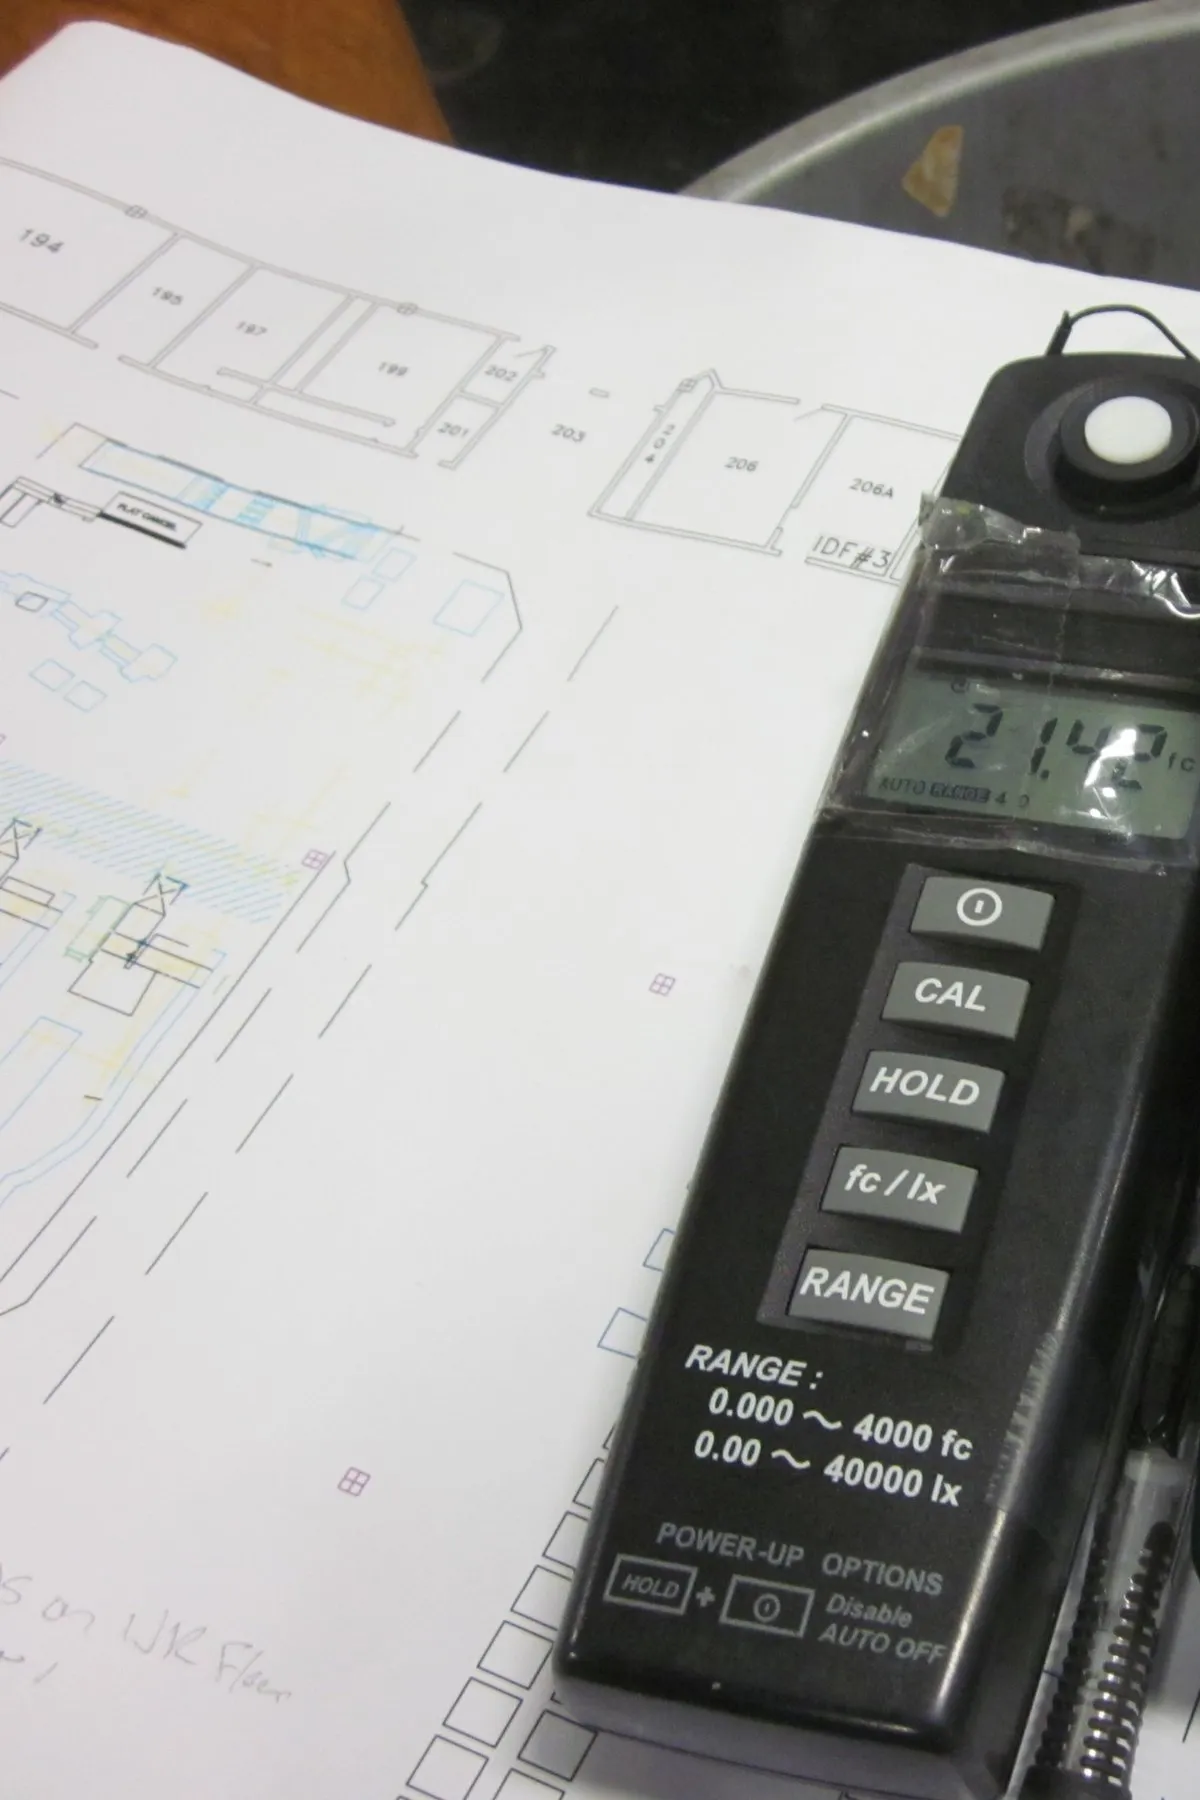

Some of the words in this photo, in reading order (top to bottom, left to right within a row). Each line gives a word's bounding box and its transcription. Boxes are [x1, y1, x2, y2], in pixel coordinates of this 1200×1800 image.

[19, 228, 64, 253] 194
[236, 321, 267, 336] 197
[485, 364, 517, 381] 202
[437, 422, 469, 437] 201
[551, 423, 586, 443] 203
[725, 456, 759, 473] 206
[850, 478, 894, 499] 206A
[813, 535, 892, 571] IDF#3
[878, 778, 926, 795] AUTO
[914, 977, 987, 1012] CAL
[869, 1066, 980, 1107] HOLD
[800, 1266, 935, 1314] RANGE
[708, 1386, 794, 1427] 0.000
[853, 1413, 933, 1453] 4000
[940, 1430, 974, 1461] fc
[694, 1430, 761, 1467] 0.00
[823, 1454, 923, 1498] 40000
[655, 1521, 805, 1569] POWER-UP
[821, 1553, 945, 1597] OPTIONS
[622, 1573, 680, 1600] HOLD
[825, 1593, 913, 1628] Disable
[818, 1623, 891, 1653] AUTO
[895, 1636, 948, 1665] OFF
